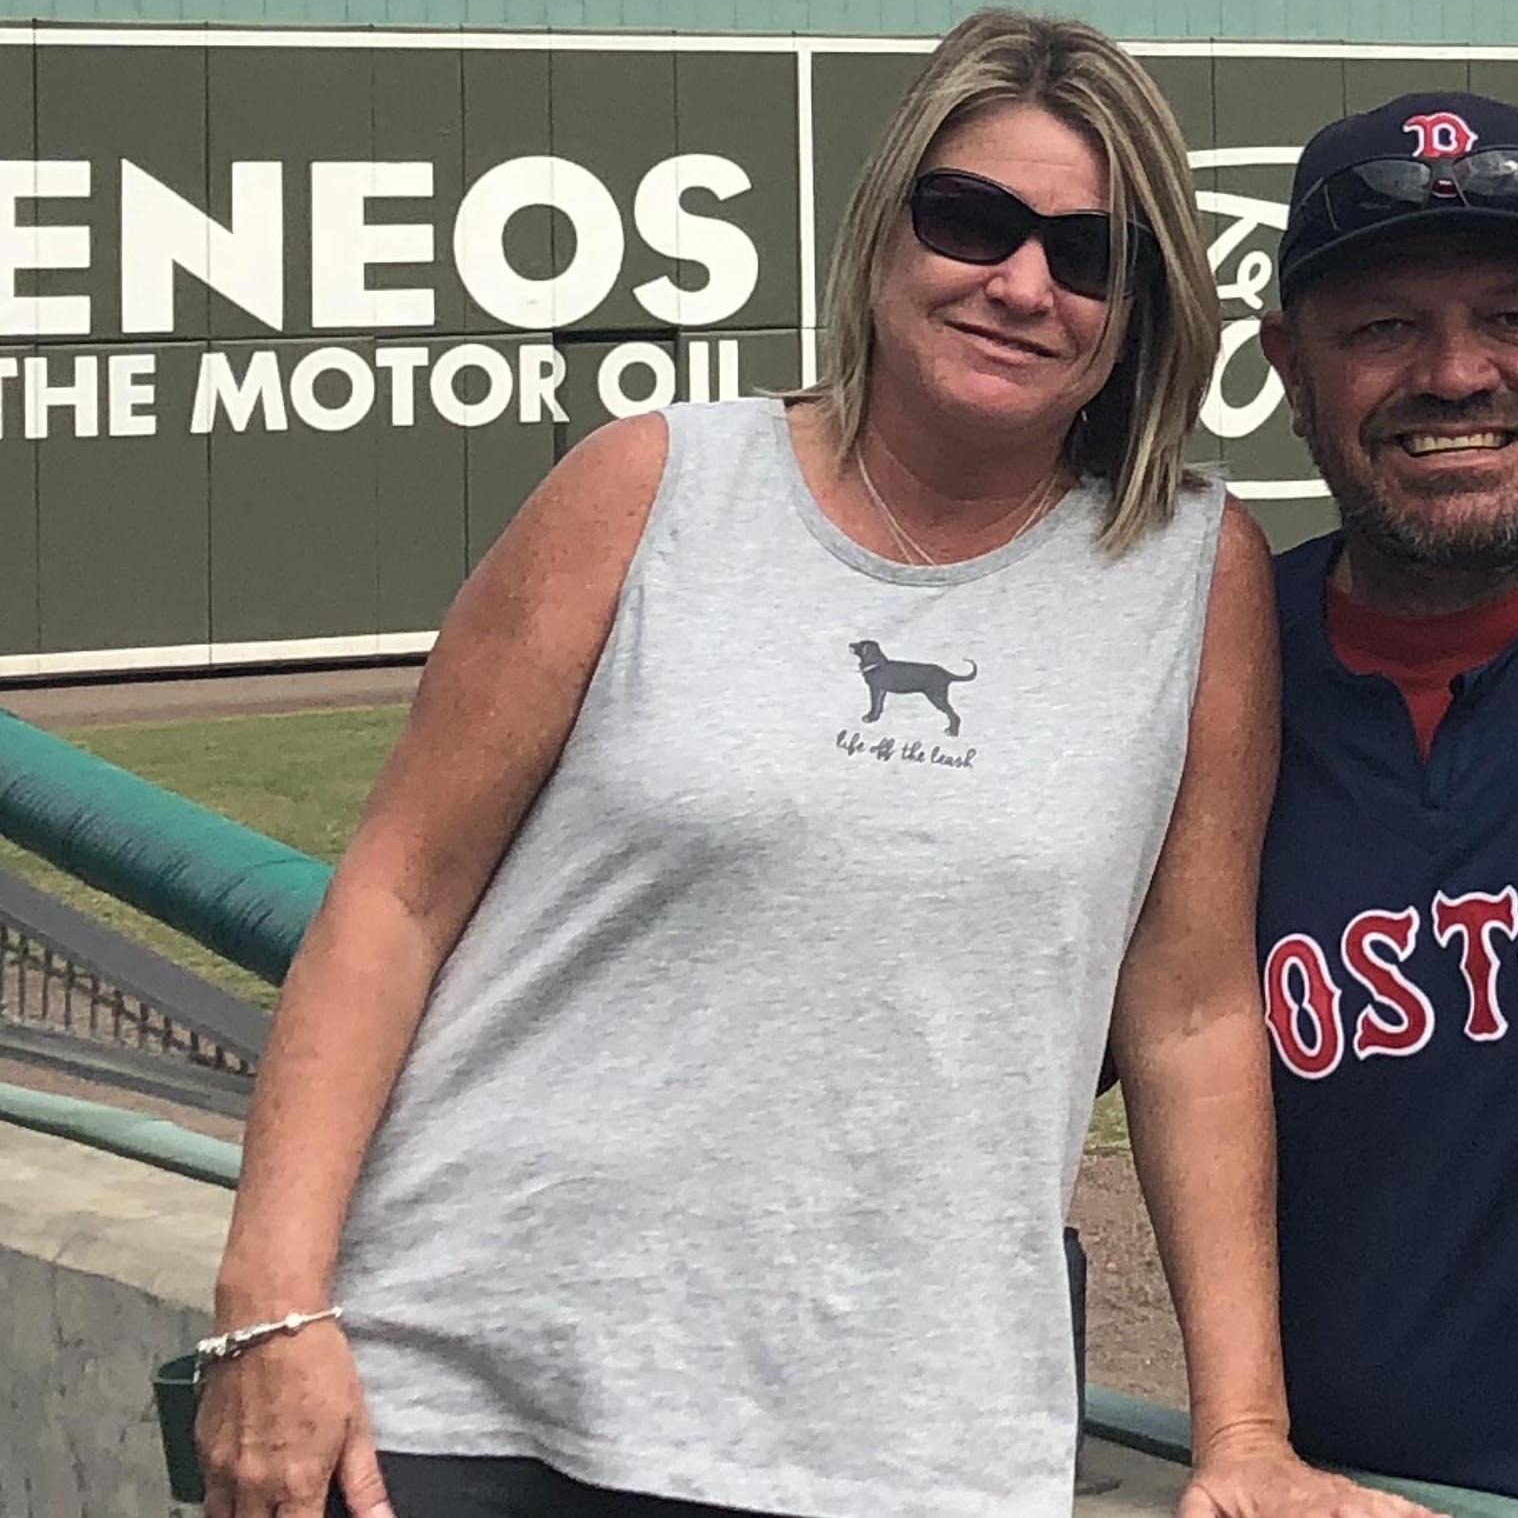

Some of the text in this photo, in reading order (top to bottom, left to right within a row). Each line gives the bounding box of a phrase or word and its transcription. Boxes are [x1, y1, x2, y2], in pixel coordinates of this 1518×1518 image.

[0, 153, 760, 336] ENEOS
[190, 343, 571, 434] MOTOR
[836, 729, 866, 756] life
[869, 737, 896, 762] off
[901, 740, 925, 763] the
